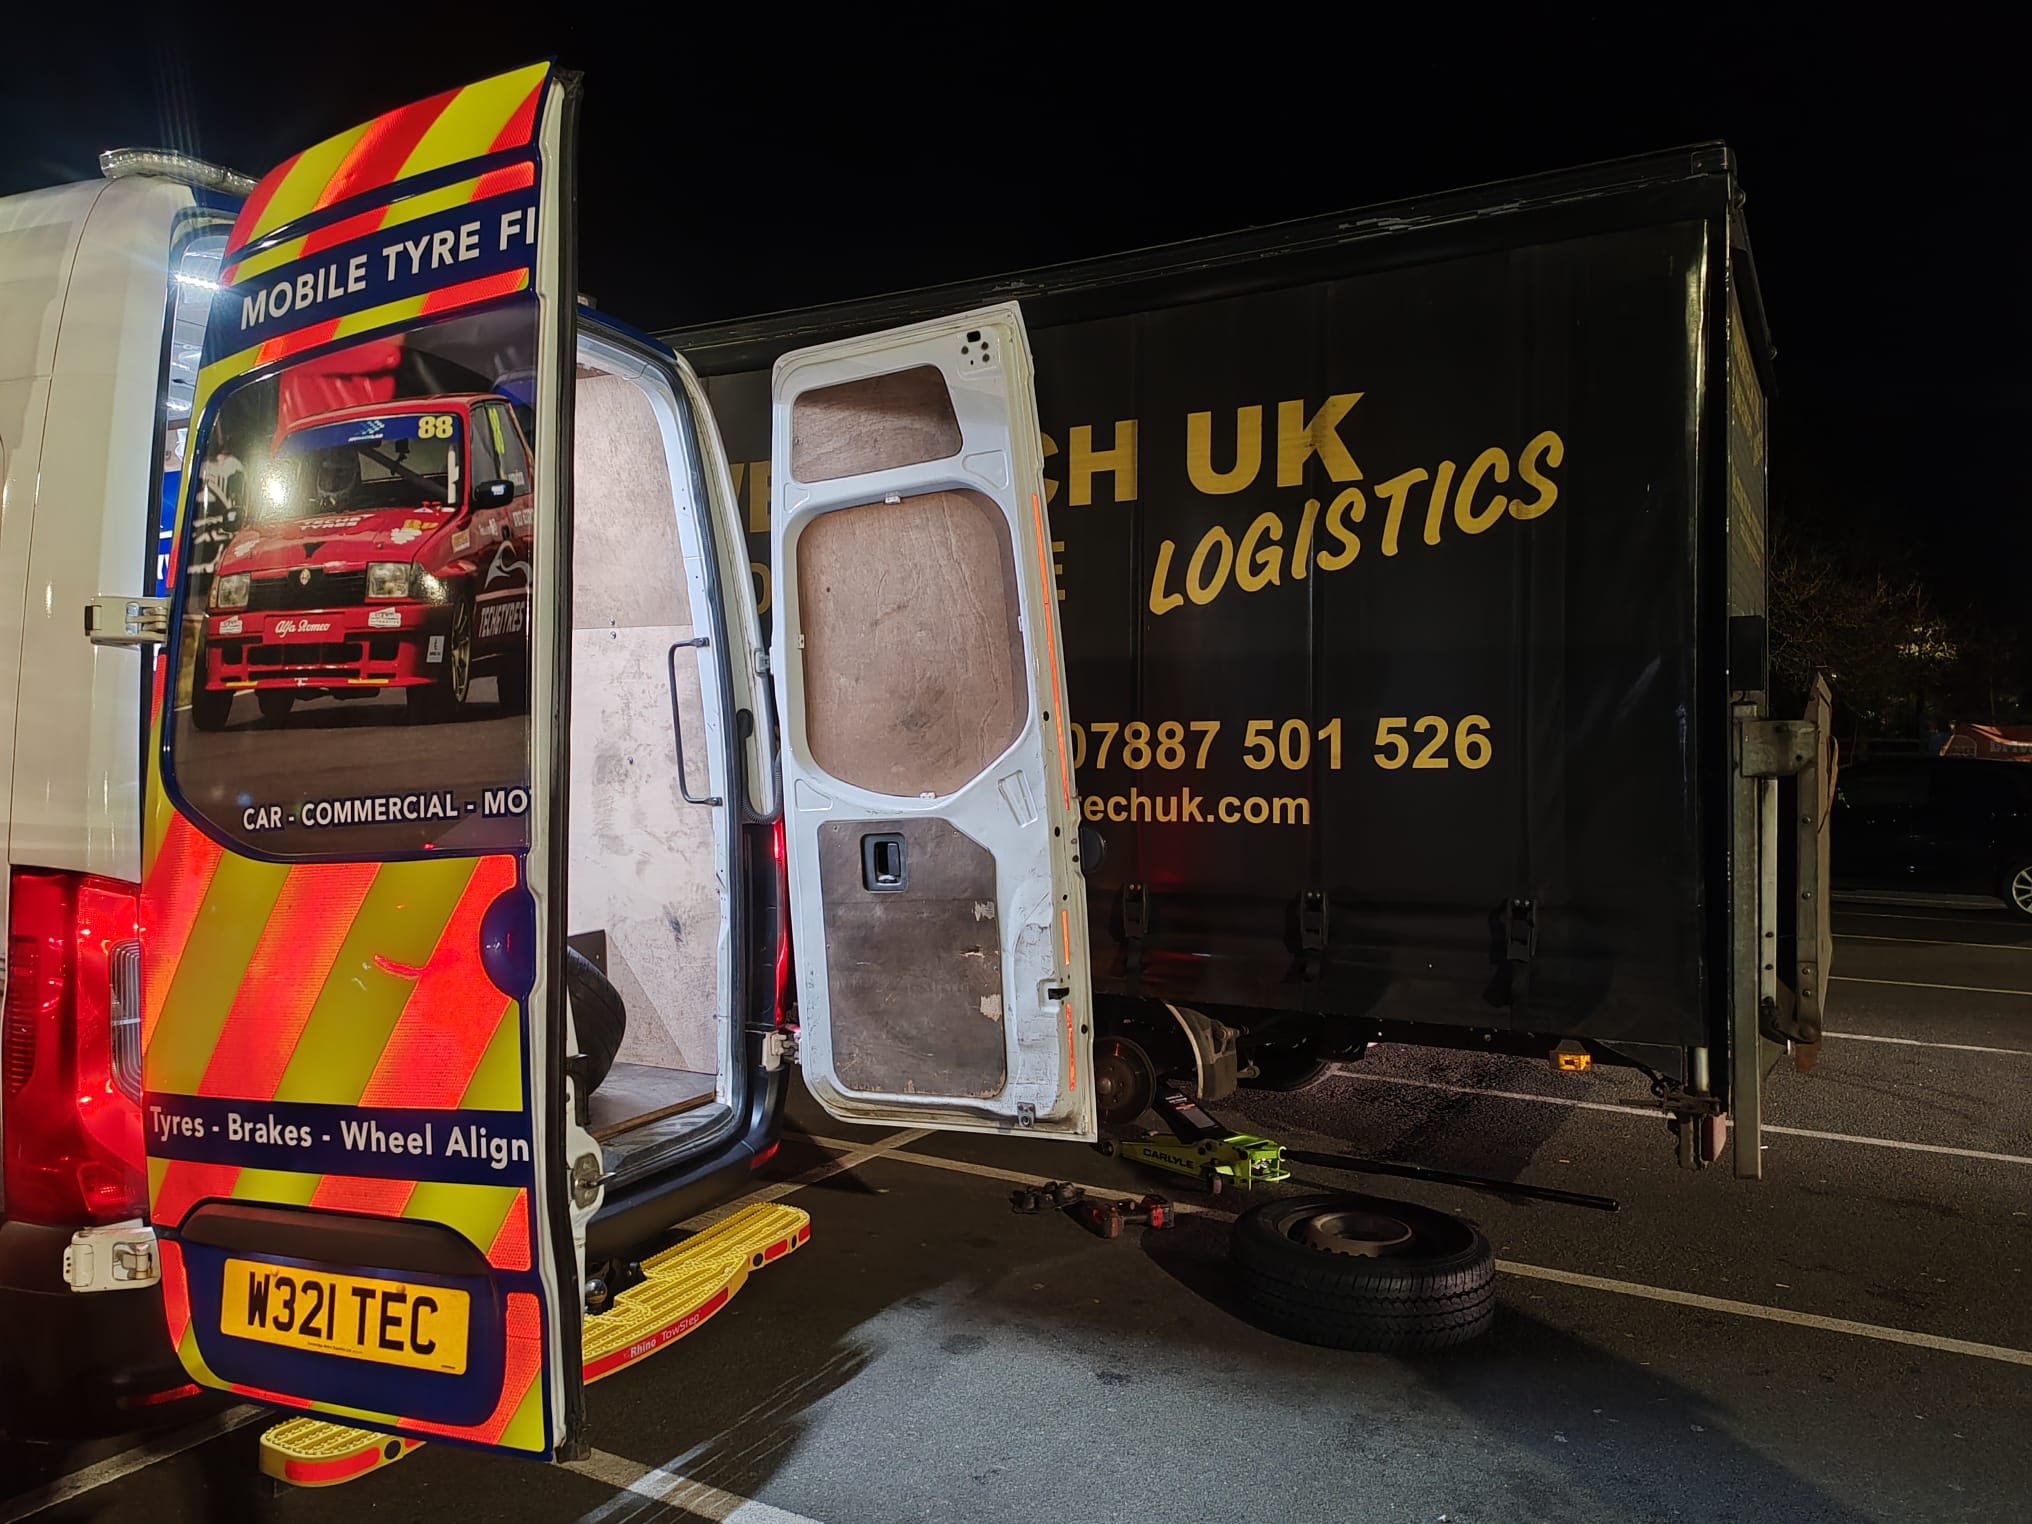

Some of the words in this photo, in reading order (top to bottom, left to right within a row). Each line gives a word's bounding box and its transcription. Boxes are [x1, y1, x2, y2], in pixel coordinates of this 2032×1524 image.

[240, 254, 368, 331] MOBILE
[382, 221, 481, 282] TYRE
[499, 207, 536, 250] FI
[418, 416, 453, 439] 88
[1187, 392, 1365, 494] UK
[1149, 431, 1564, 615] LOGISTICS
[275, 620, 296, 638] Alfa
[297, 619, 331, 633] Romeo
[1243, 718, 1341, 770] 501
[1373, 715, 1492, 769] 526
[243, 806, 282, 830] CAR
[302, 794, 458, 826] COMMERCIAL
[484, 789, 532, 815] MO
[1077, 787, 1311, 825] echuk.com
[150, 1106, 205, 1142] Tyres
[227, 1112, 312, 1148] Brakes
[340, 1120, 433, 1155] Wheel
[445, 1125, 530, 1170] Align
[1143, 1147, 1194, 1169] CARLYLE
[247, 1271, 336, 1341] W321
[351, 1286, 438, 1355] TEC
[630, 1338, 657, 1358] Rhino
[661, 1313, 700, 1341] TowStep
